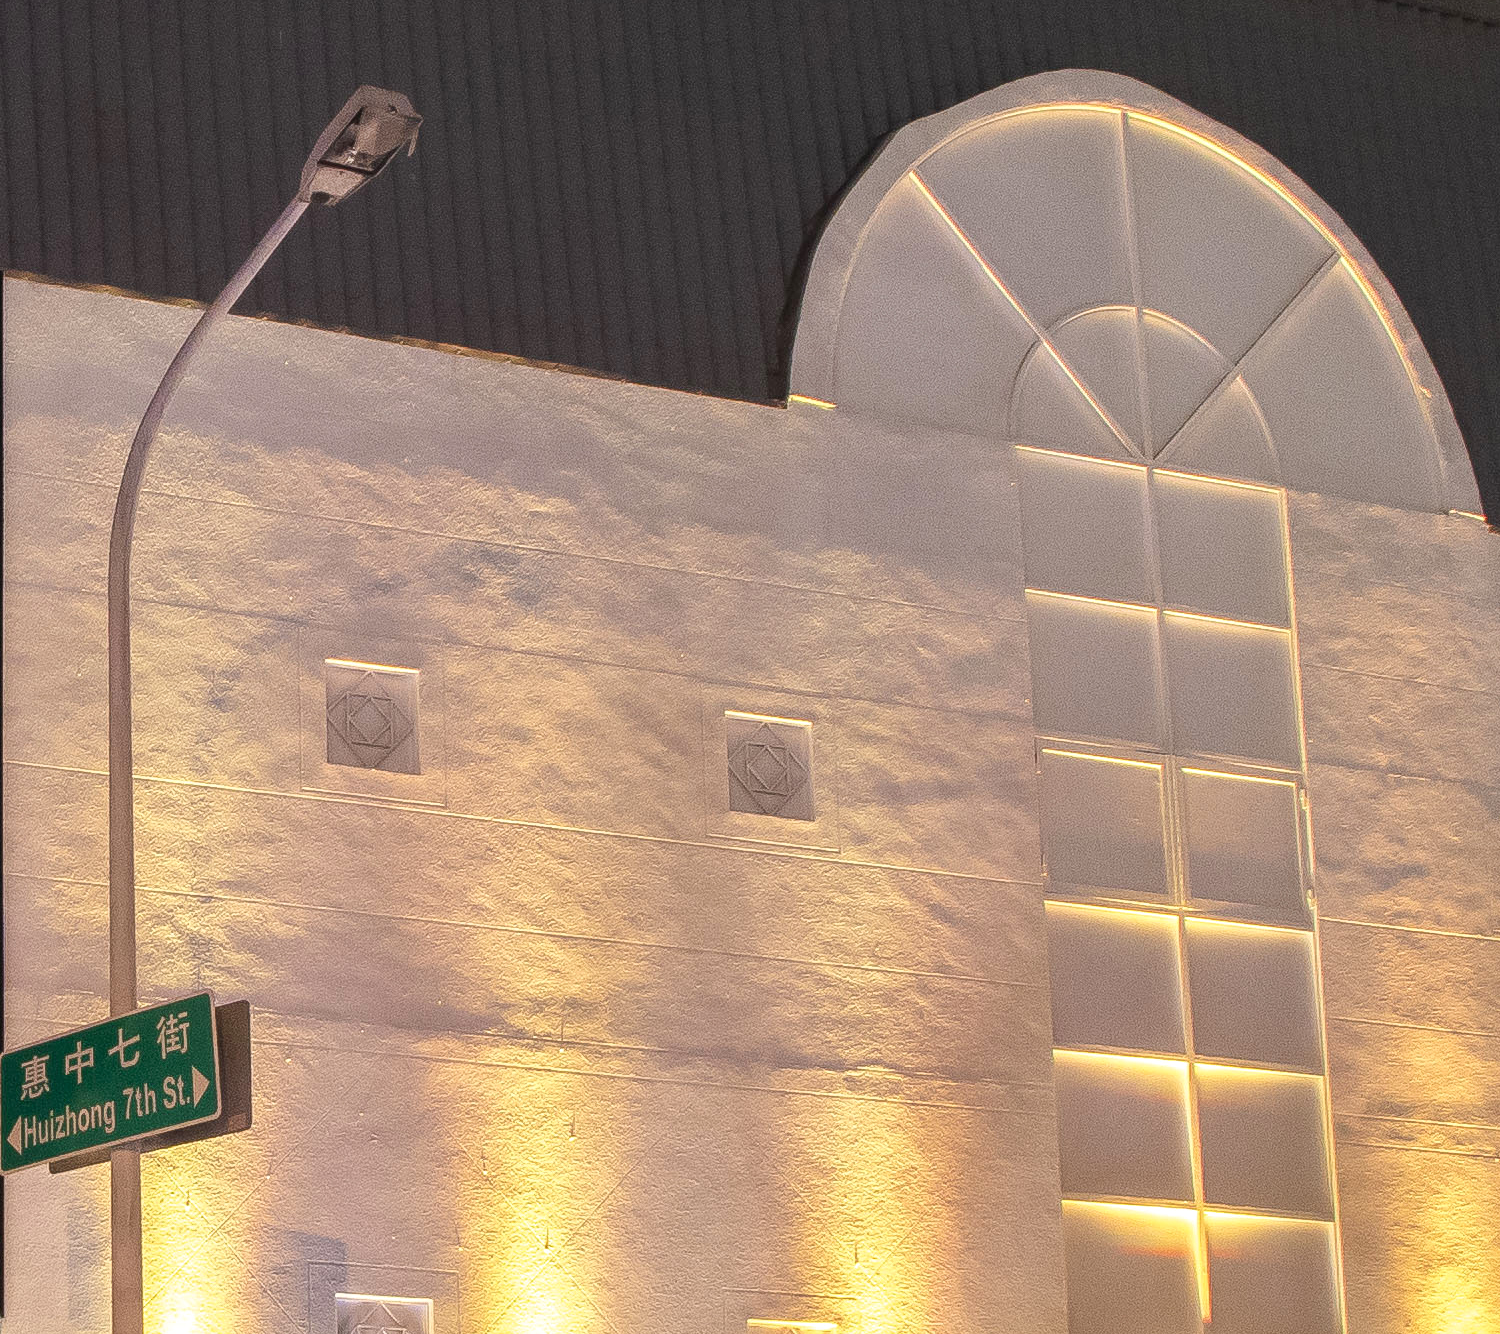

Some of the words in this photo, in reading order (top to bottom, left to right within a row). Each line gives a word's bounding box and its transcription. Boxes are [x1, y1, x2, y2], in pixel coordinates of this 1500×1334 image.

[20, 1011, 190, 1101] 惠中七街
[23, 1098, 116, 1149] Huizhong
[122, 1082, 157, 1121] 7th
[162, 1074, 192, 1110] St.
